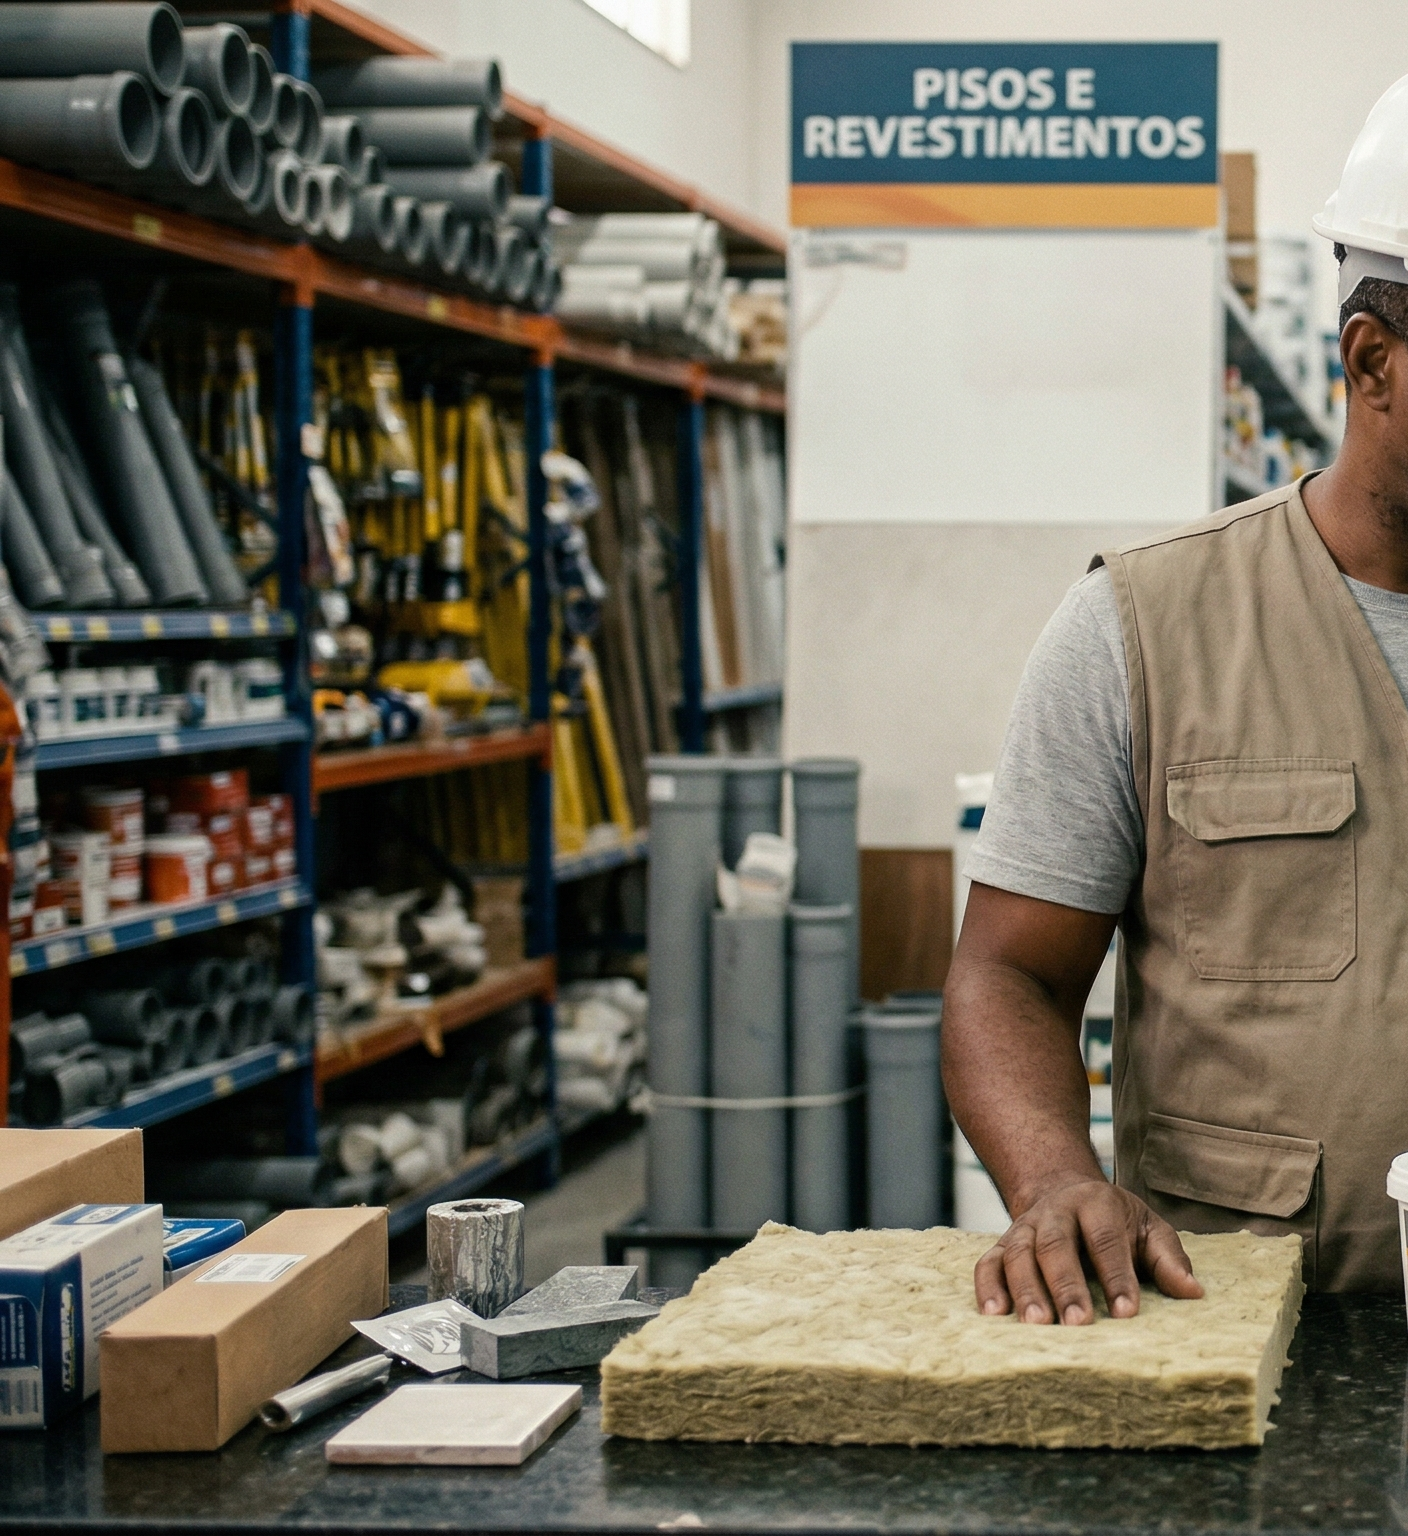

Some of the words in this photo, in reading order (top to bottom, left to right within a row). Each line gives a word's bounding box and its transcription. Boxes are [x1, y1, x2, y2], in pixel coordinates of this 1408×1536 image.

[914, 68, 1055, 110] PISOS
[1067, 68, 1095, 110] E
[804, 115, 1205, 158] REVESTIMENTOS
